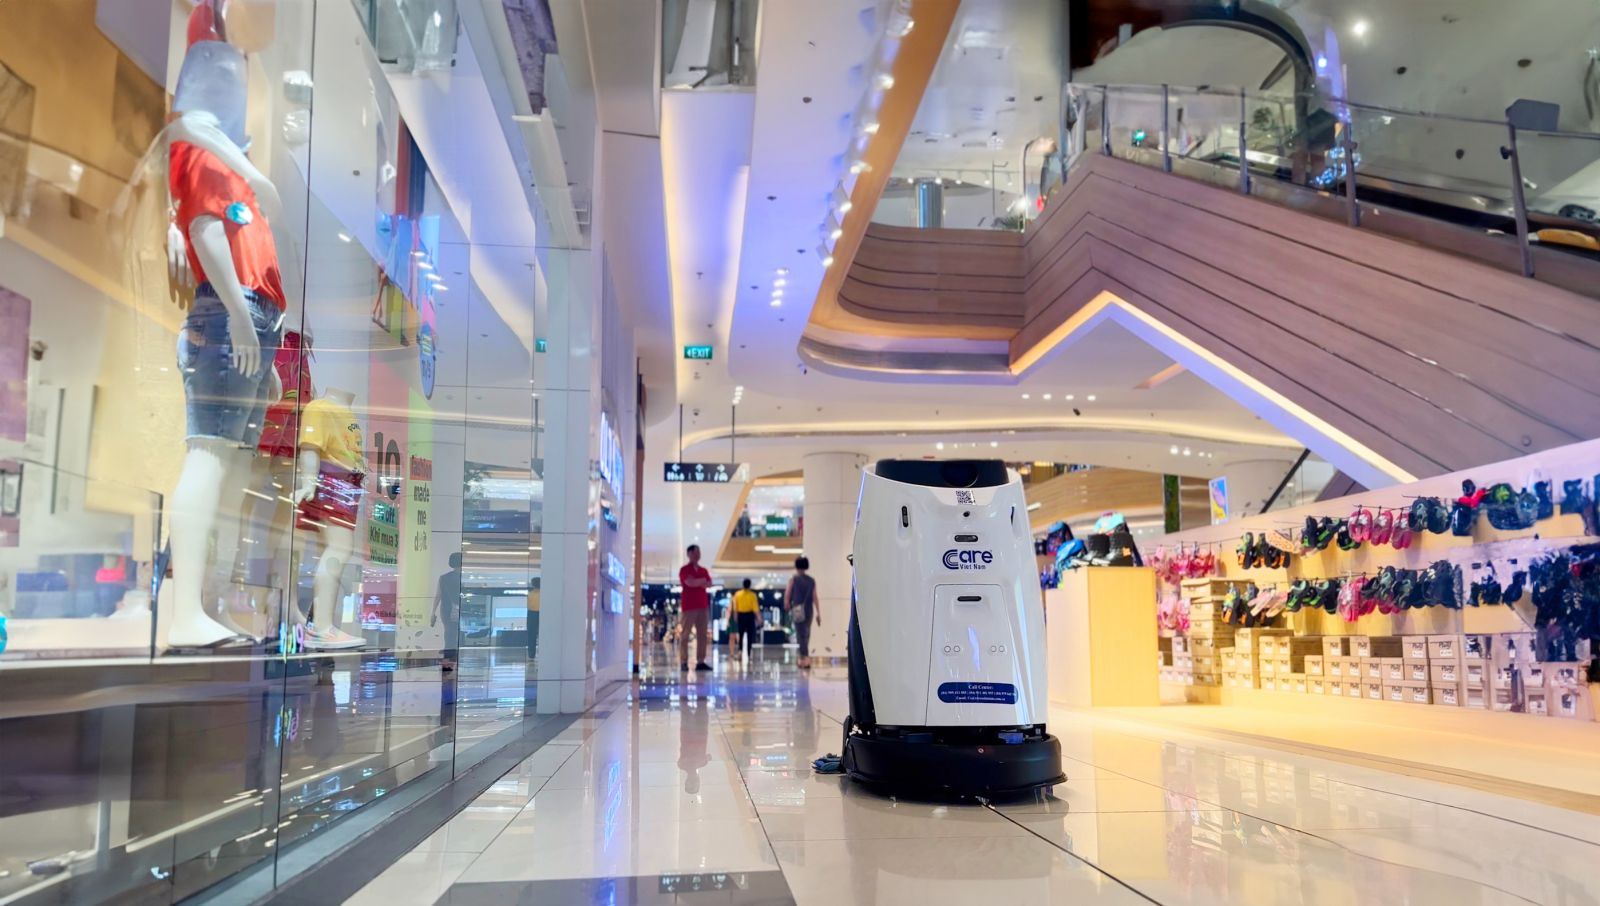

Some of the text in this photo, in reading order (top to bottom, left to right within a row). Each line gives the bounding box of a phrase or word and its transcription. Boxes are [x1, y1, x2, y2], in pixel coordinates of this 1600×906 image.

[691, 347, 710, 358] EXIT
[374, 432, 401, 500] 10
[414, 482, 430, 502] made
[417, 509, 427, 525] me
[370, 526, 381, 543] Khi
[381, 533, 394, 547] mua
